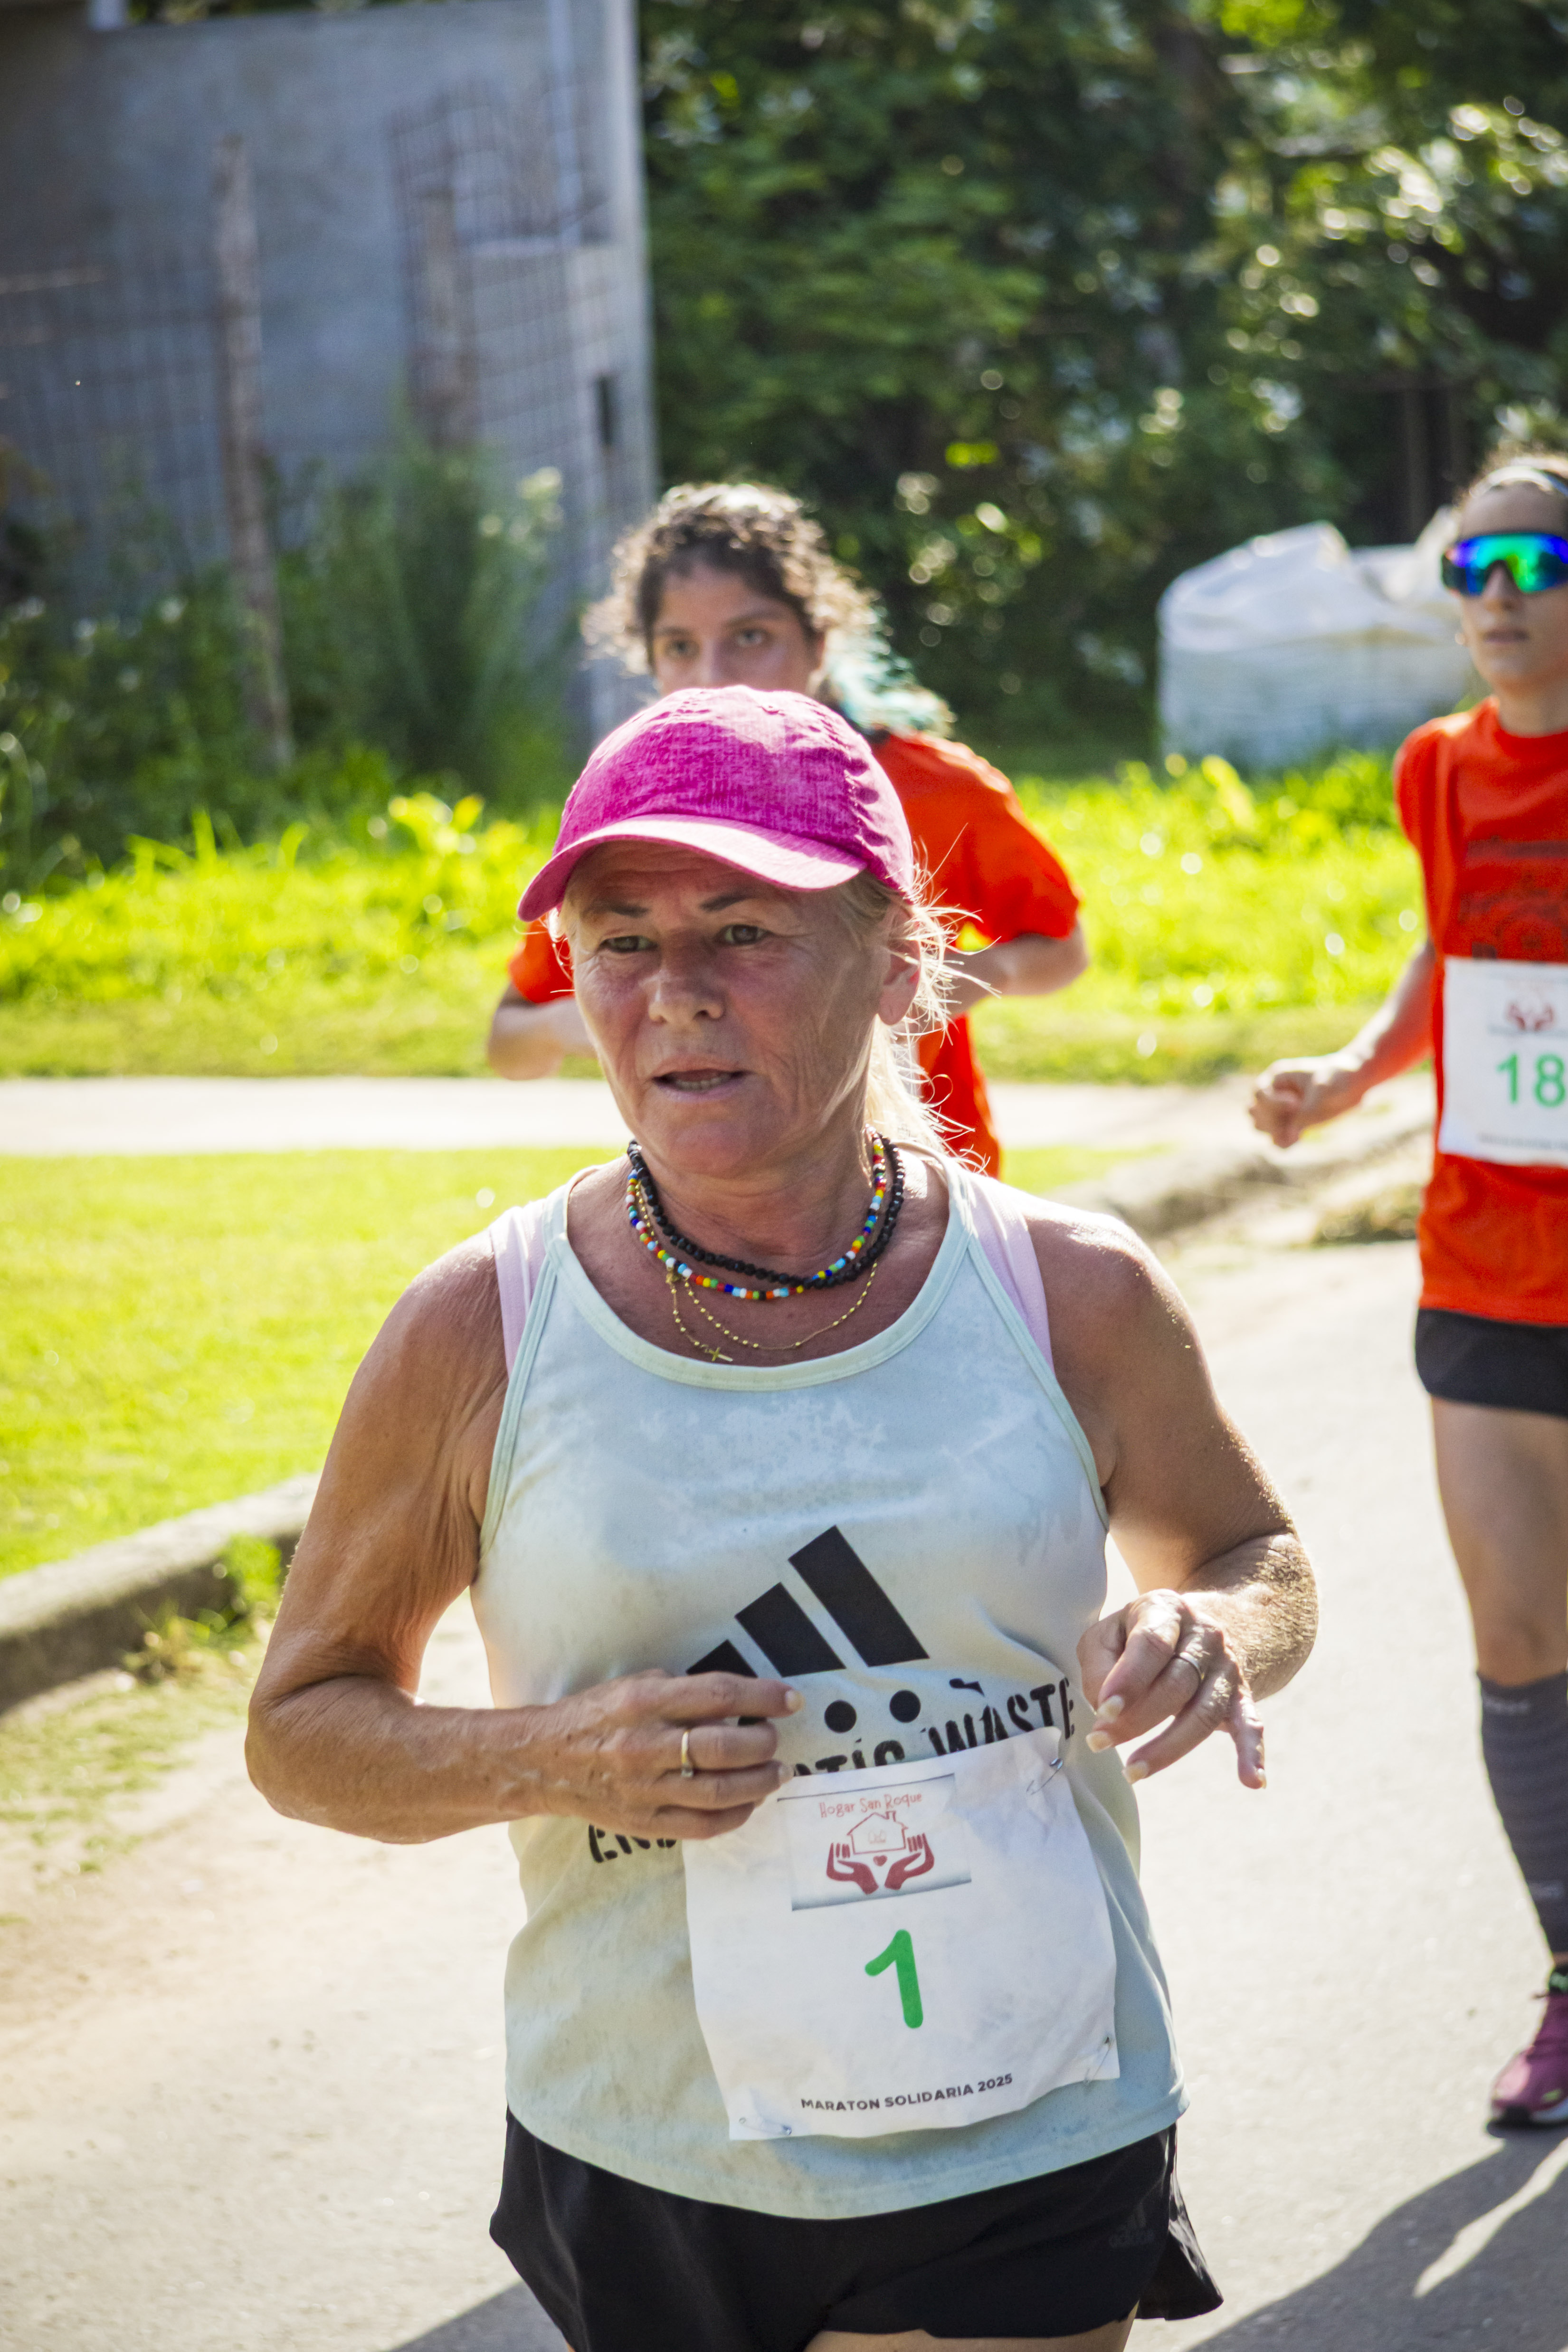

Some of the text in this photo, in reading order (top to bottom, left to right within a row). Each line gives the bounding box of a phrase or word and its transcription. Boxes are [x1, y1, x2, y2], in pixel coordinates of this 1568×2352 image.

[1497, 1053, 1567, 1108] 18
[819, 1792, 922, 1818] Hogar San Roque
[865, 1929, 924, 2028] 1
[800, 2073, 1013, 2111] MARATON SOLIDARIA 2025
